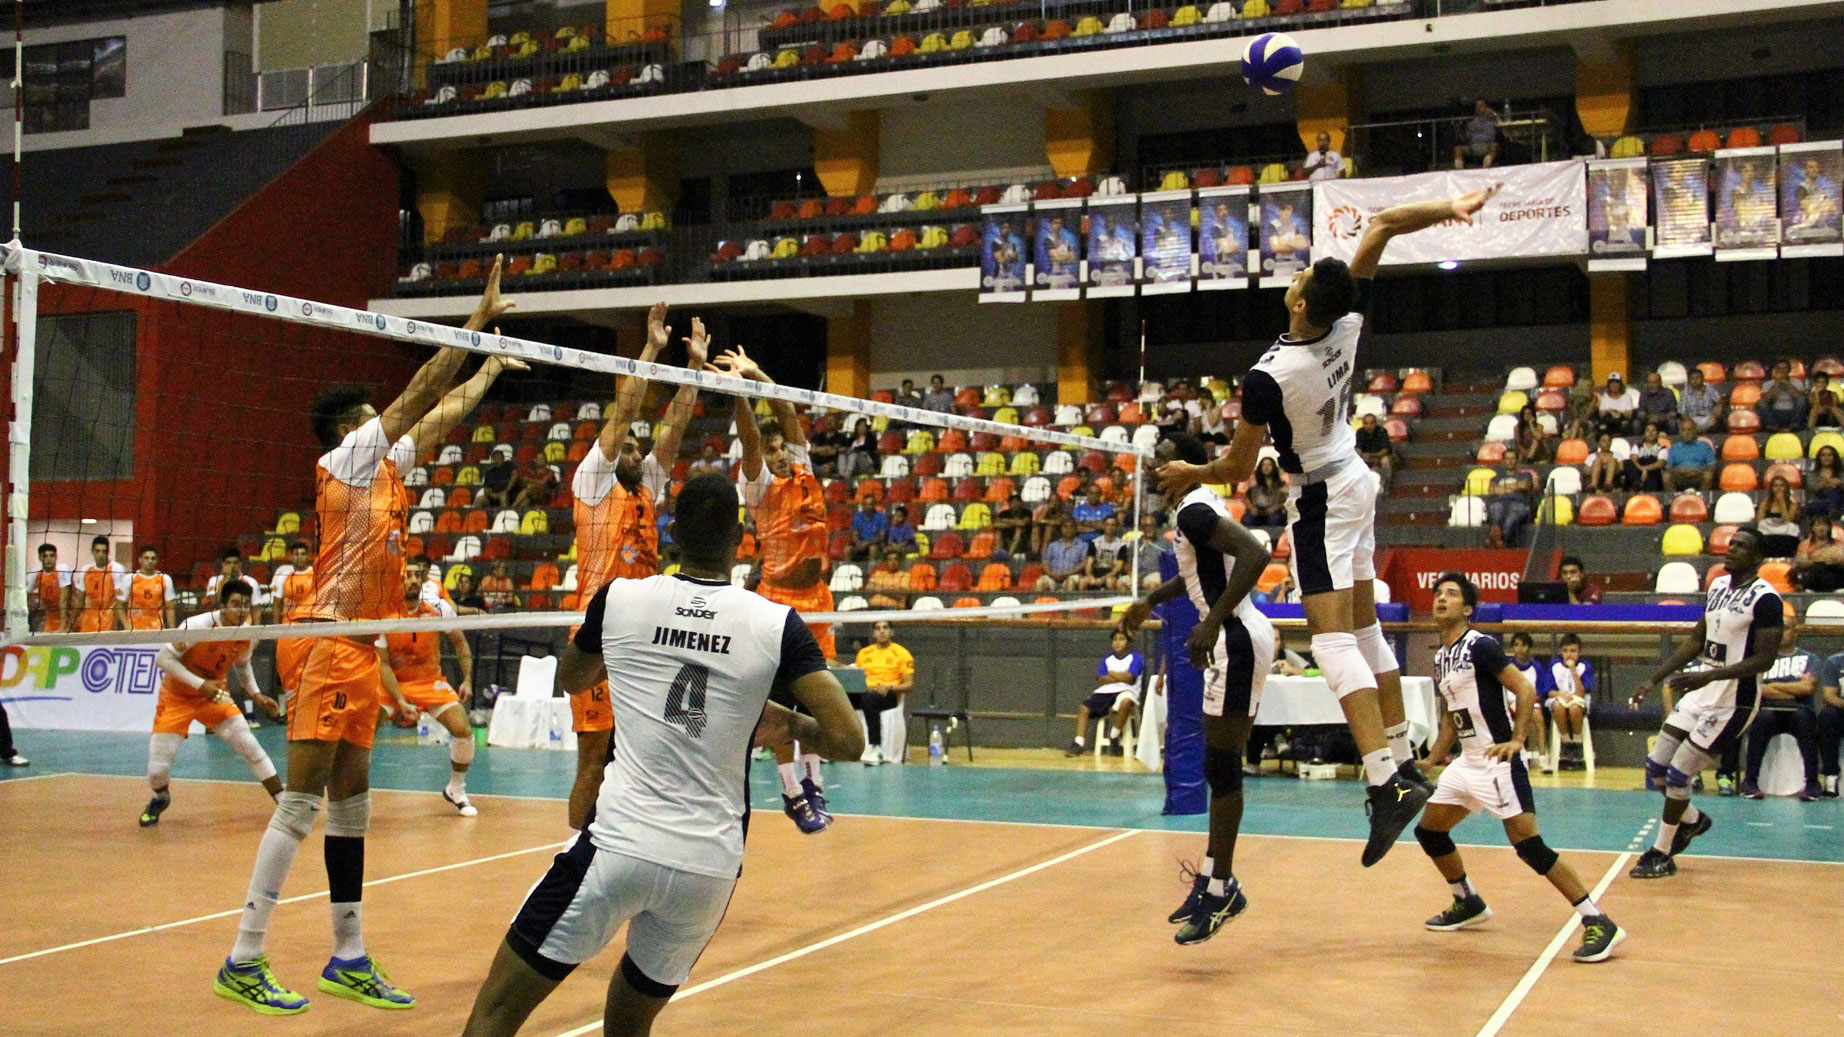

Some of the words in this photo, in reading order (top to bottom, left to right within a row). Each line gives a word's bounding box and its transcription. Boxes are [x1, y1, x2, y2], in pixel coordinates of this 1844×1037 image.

[1499, 206, 1571, 222] DEPORTES
[110, 269, 133, 285] BNA
[242, 291, 262, 305] BNA
[356, 312, 374, 325] BNA
[1327, 360, 1349, 389] LIMA
[1417, 572, 1520, 590] VEARIOS
[652, 626, 731, 655] JIMENEZ
[333, 691, 347, 710] 10
[591, 687, 603, 701] 12
[664, 662, 710, 739] 4
